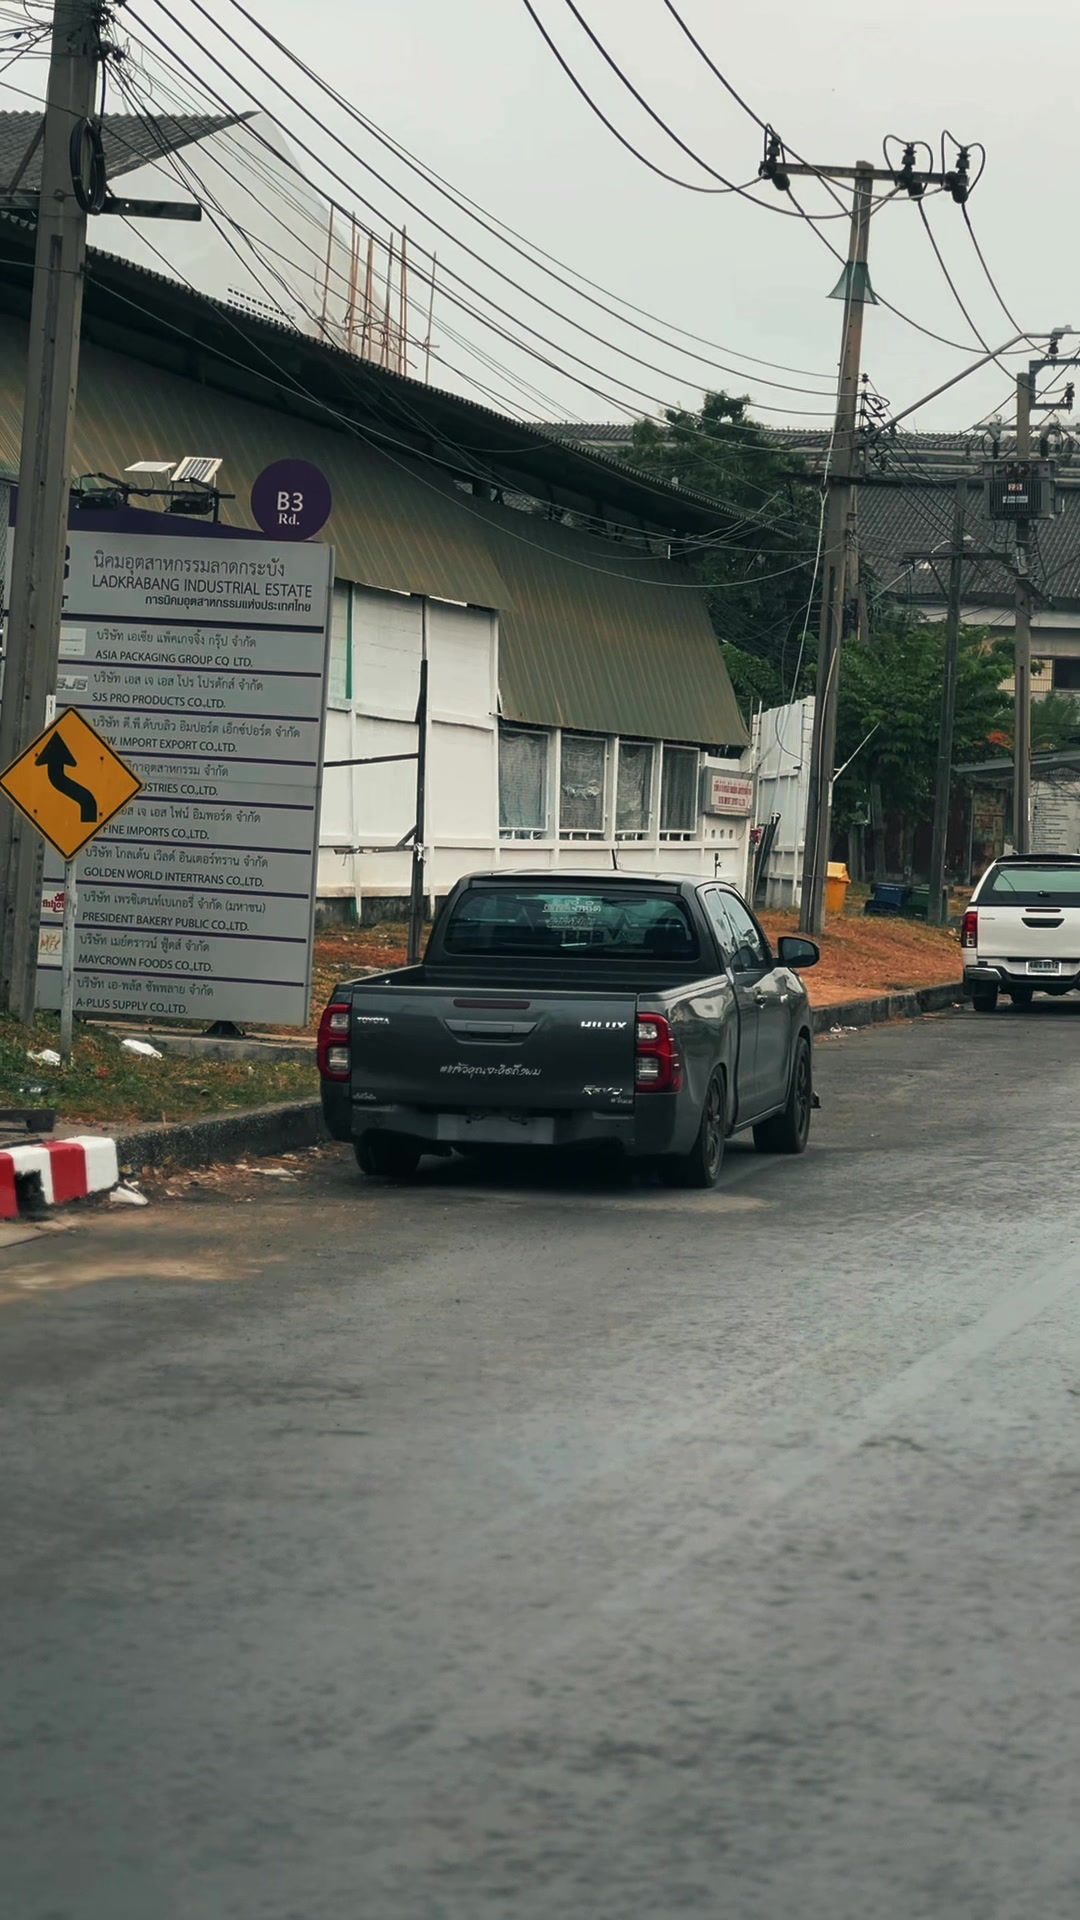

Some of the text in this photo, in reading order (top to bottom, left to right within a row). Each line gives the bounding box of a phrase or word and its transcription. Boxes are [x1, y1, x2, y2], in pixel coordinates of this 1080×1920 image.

[277, 491, 304, 512] B3
[279, 512, 300, 525] Rd.
[93, 549, 285, 576] นิคมอุตสาหกรรมลาดกระบัง
[92, 574, 312, 598] LADKRABANG INDUSTRIAL ESTATE
[145, 594, 311, 612] การนิคมอุตสาหกรรมแห่งประเทศไทย
[97, 628, 123, 640] บริษัท
[232, 634, 256, 647] จำกัด
[95, 650, 117, 660] ASIA
[120, 651, 176, 663] PACKAGING
[178, 654, 213, 665] GROUP
[94, 671, 121, 683] บริษัท
[239, 678, 263, 691] จำกัด
[92, 692, 107, 702] SJS
[109, 693, 130, 703] PRO
[132, 695, 185, 706] PRODUCTS
[93, 716, 119, 728] บริษัท
[275, 725, 300, 737] จำกัด
[120, 737, 157, 747] IMPORT
[160, 739, 198, 750] EXPORT
[204, 764, 228, 776] จำกัด
[236, 811, 261, 822] จำกัด
[127, 826, 169, 837] IMPORTS
[86, 845, 112, 858] บริษัท
[244, 855, 268, 867] จำกัด
[84, 867, 125, 878] GOLDEN
[126, 870, 163, 881] WORLD
[165, 872, 223, 884] INTERTRANS
[84, 891, 110, 903] บริษัท
[198, 897, 222, 909] จำกัด
[225, 901, 266, 913] (มหาชน)
[82, 912, 134, 923] PRESIDENT
[136, 915, 173, 926] BAKERY
[175, 918, 209, 929] PUBLIC
[80, 933, 107, 945] บริษัท
[185, 940, 210, 952] จำกัด
[78, 954, 136, 966] MAYCROWN
[139, 958, 172, 969] FOODS
[77, 977, 104, 988] บริษัท
[189, 984, 214, 996] จำกัด
[76, 998, 110, 1009] A-PLUS
[112, 1000, 148, 1011] SUPPLY
[357, 1016, 390, 1024] TOYOTA
